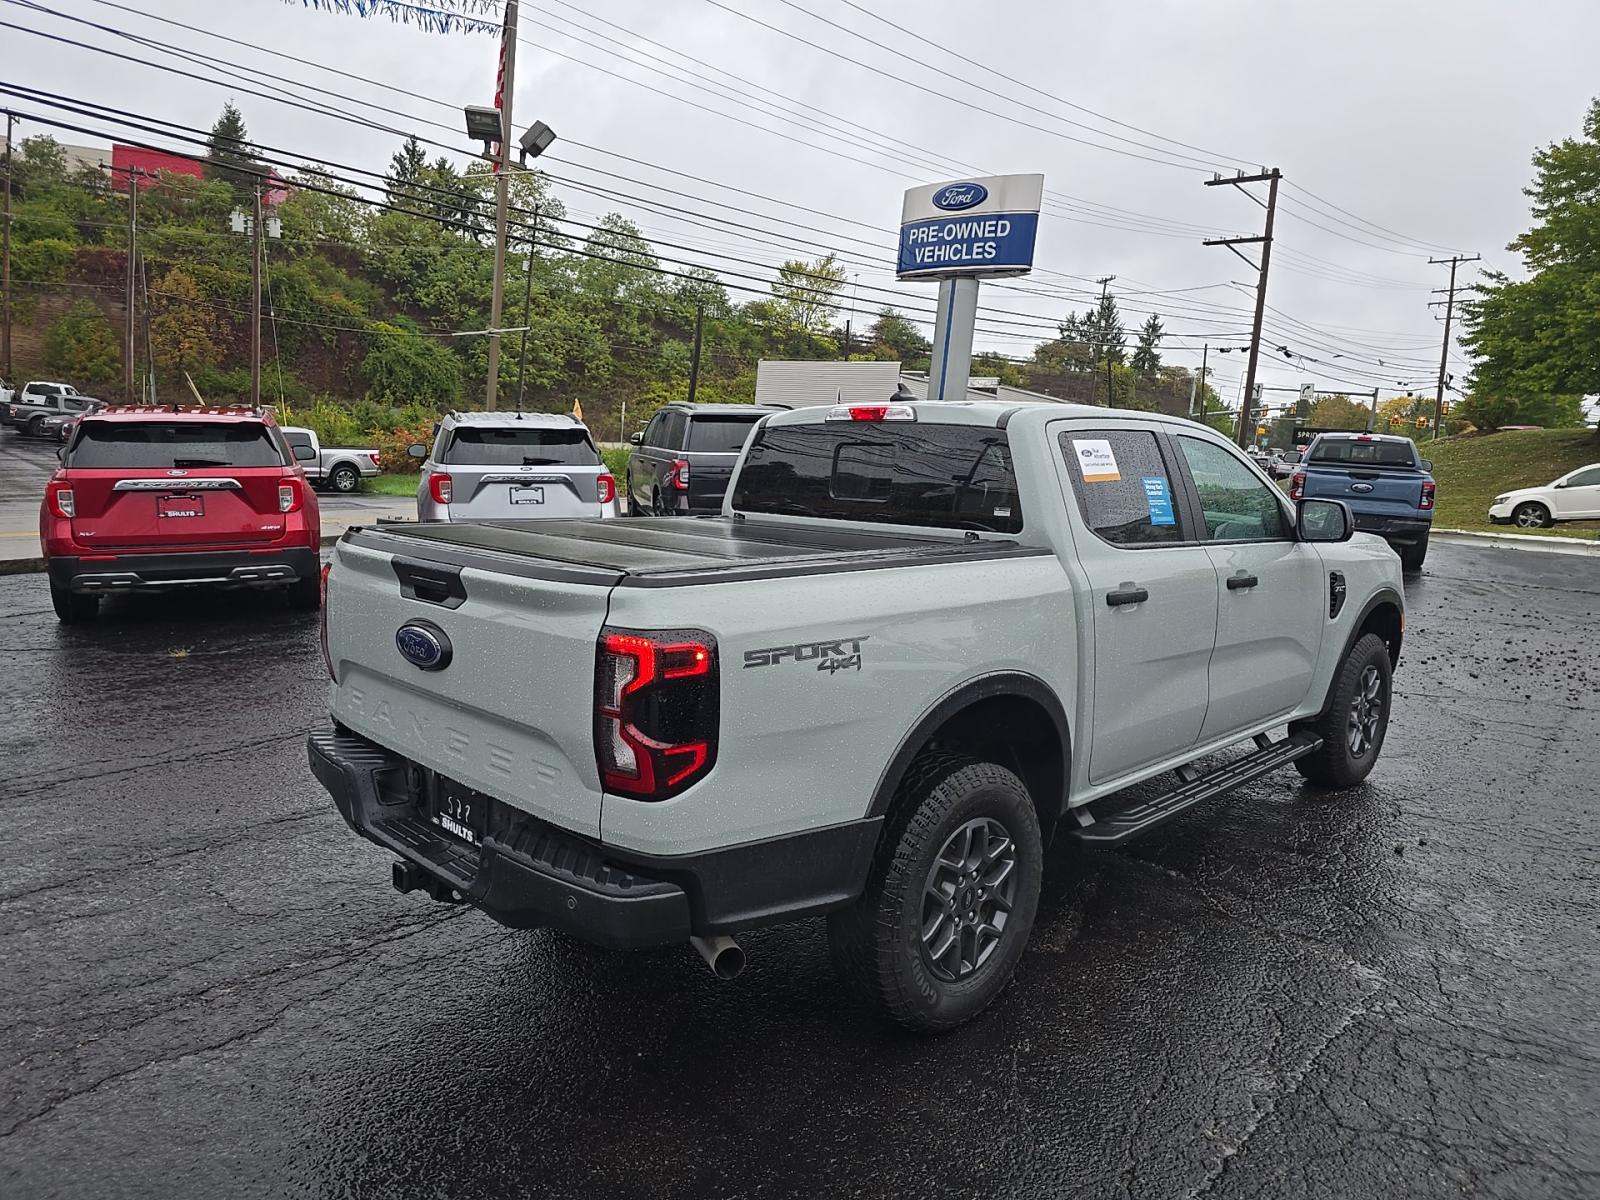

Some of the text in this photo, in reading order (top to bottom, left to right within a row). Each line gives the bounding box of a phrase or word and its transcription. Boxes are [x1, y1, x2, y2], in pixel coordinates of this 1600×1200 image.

[941, 186, 975, 206] Ford
[909, 220, 1011, 245] PRE-OWNED
[915, 242, 997, 263] VEHICLES
[743, 635, 870, 669] SPORT
[817, 653, 862, 676] 4x4
[441, 817, 474, 843] SHULTS
